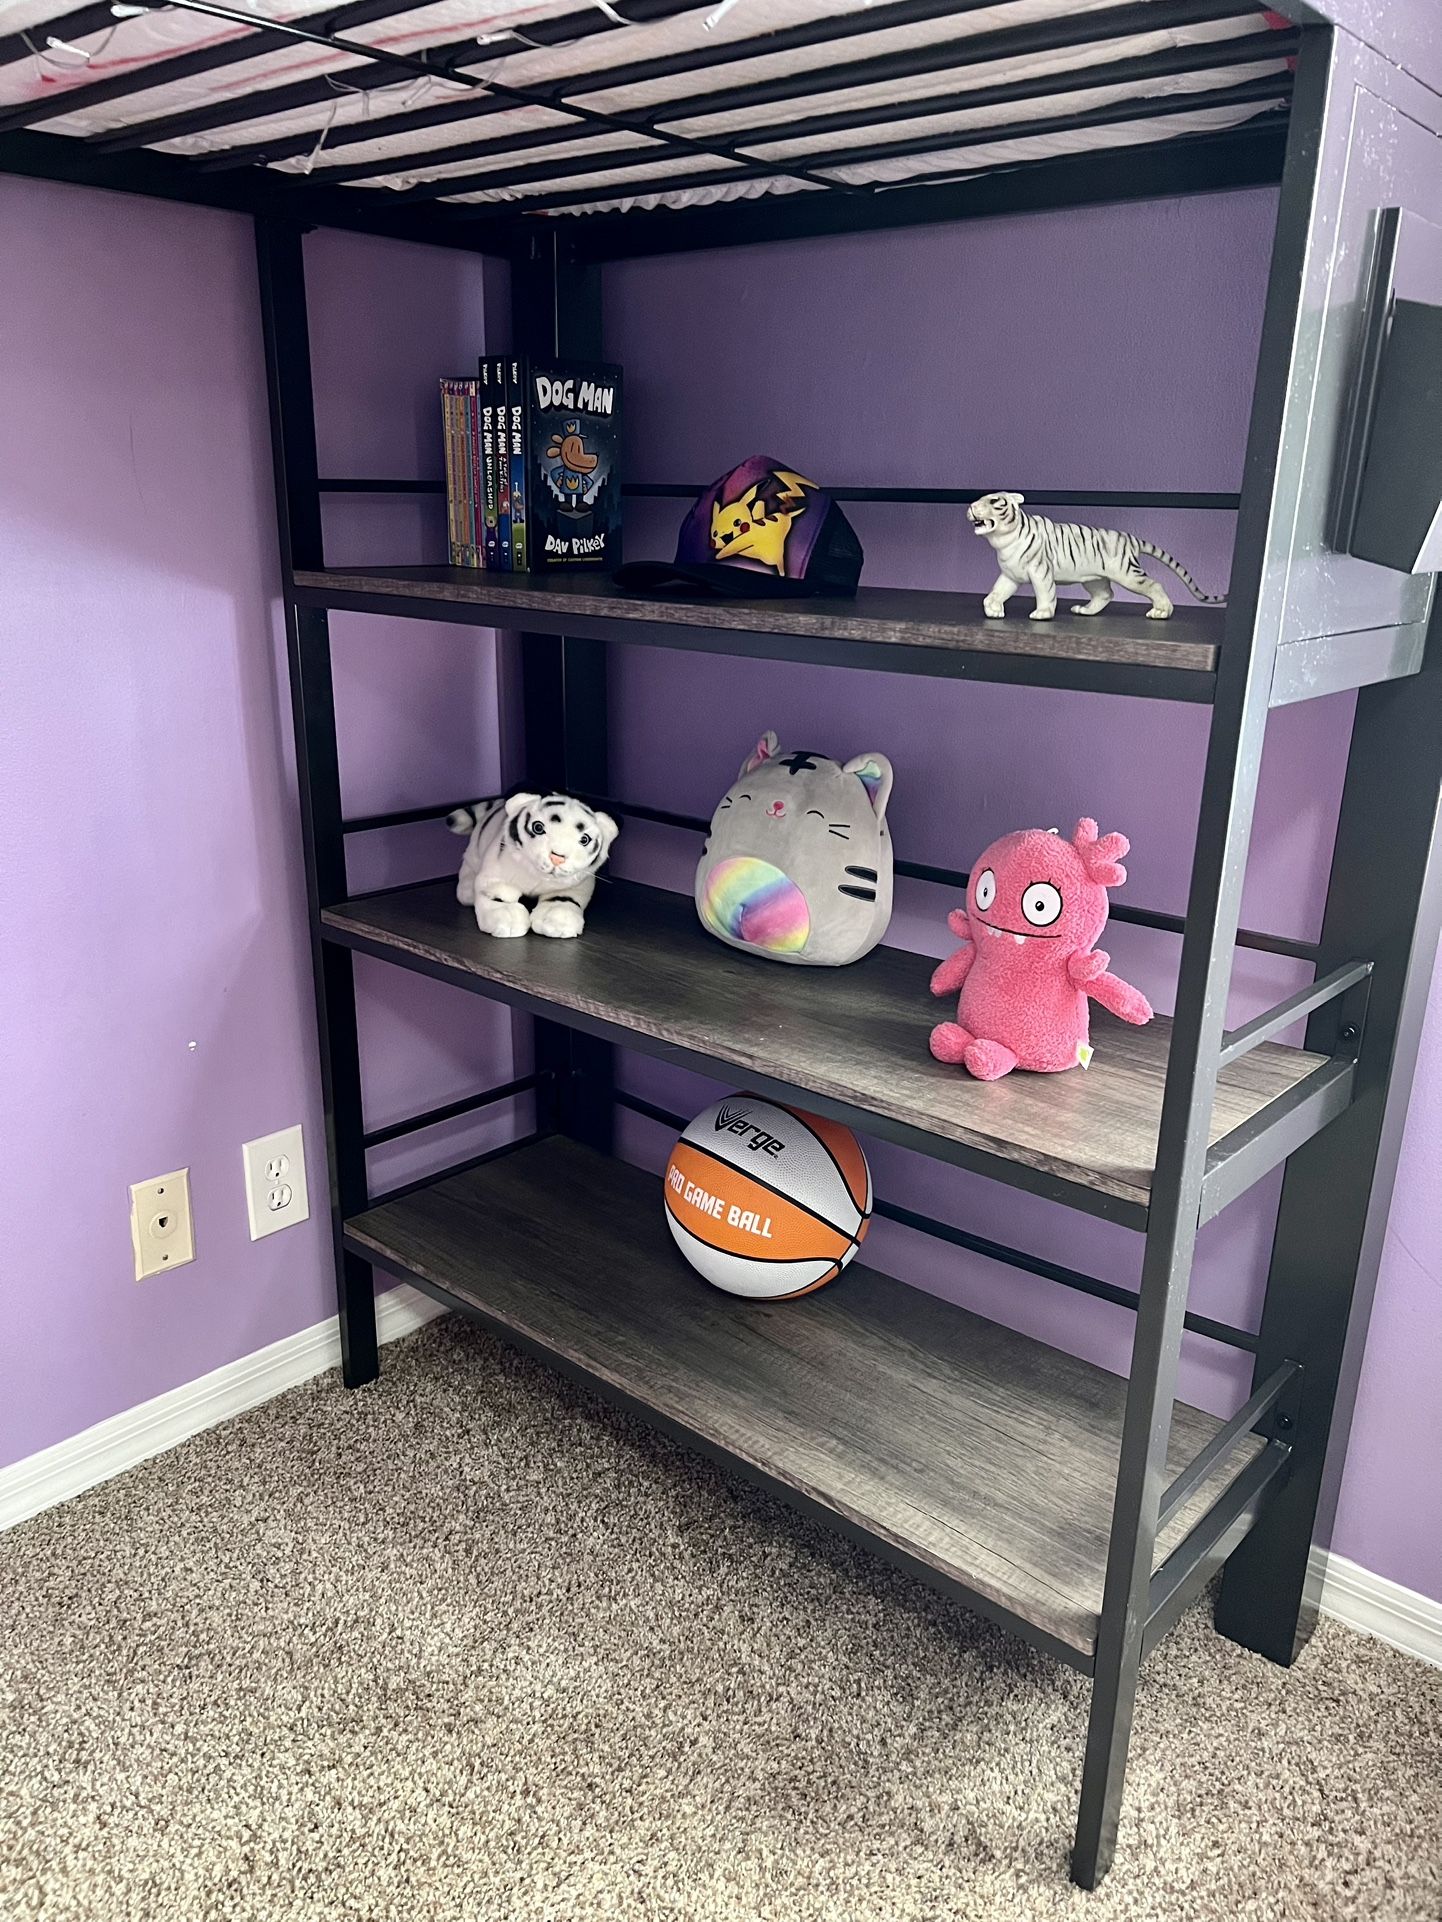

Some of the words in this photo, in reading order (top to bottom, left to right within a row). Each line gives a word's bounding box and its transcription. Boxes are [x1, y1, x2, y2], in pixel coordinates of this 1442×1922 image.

[535, 377, 574, 409] DOG
[577, 381, 614, 414] MAN
[483, 406, 492, 430] DOG
[497, 406, 506, 430] DOG
[512, 406, 522, 430] DOG
[484, 432, 493, 454] MAN
[498, 432, 507, 454] MAN
[512, 432, 522, 454] MAN
[545, 534, 569, 554] DAV
[715, 1104, 786, 1154] Verge
[668, 1164, 686, 1195] PRO
[684, 1180, 726, 1220] GAME
[727, 1205, 773, 1239] BALL
